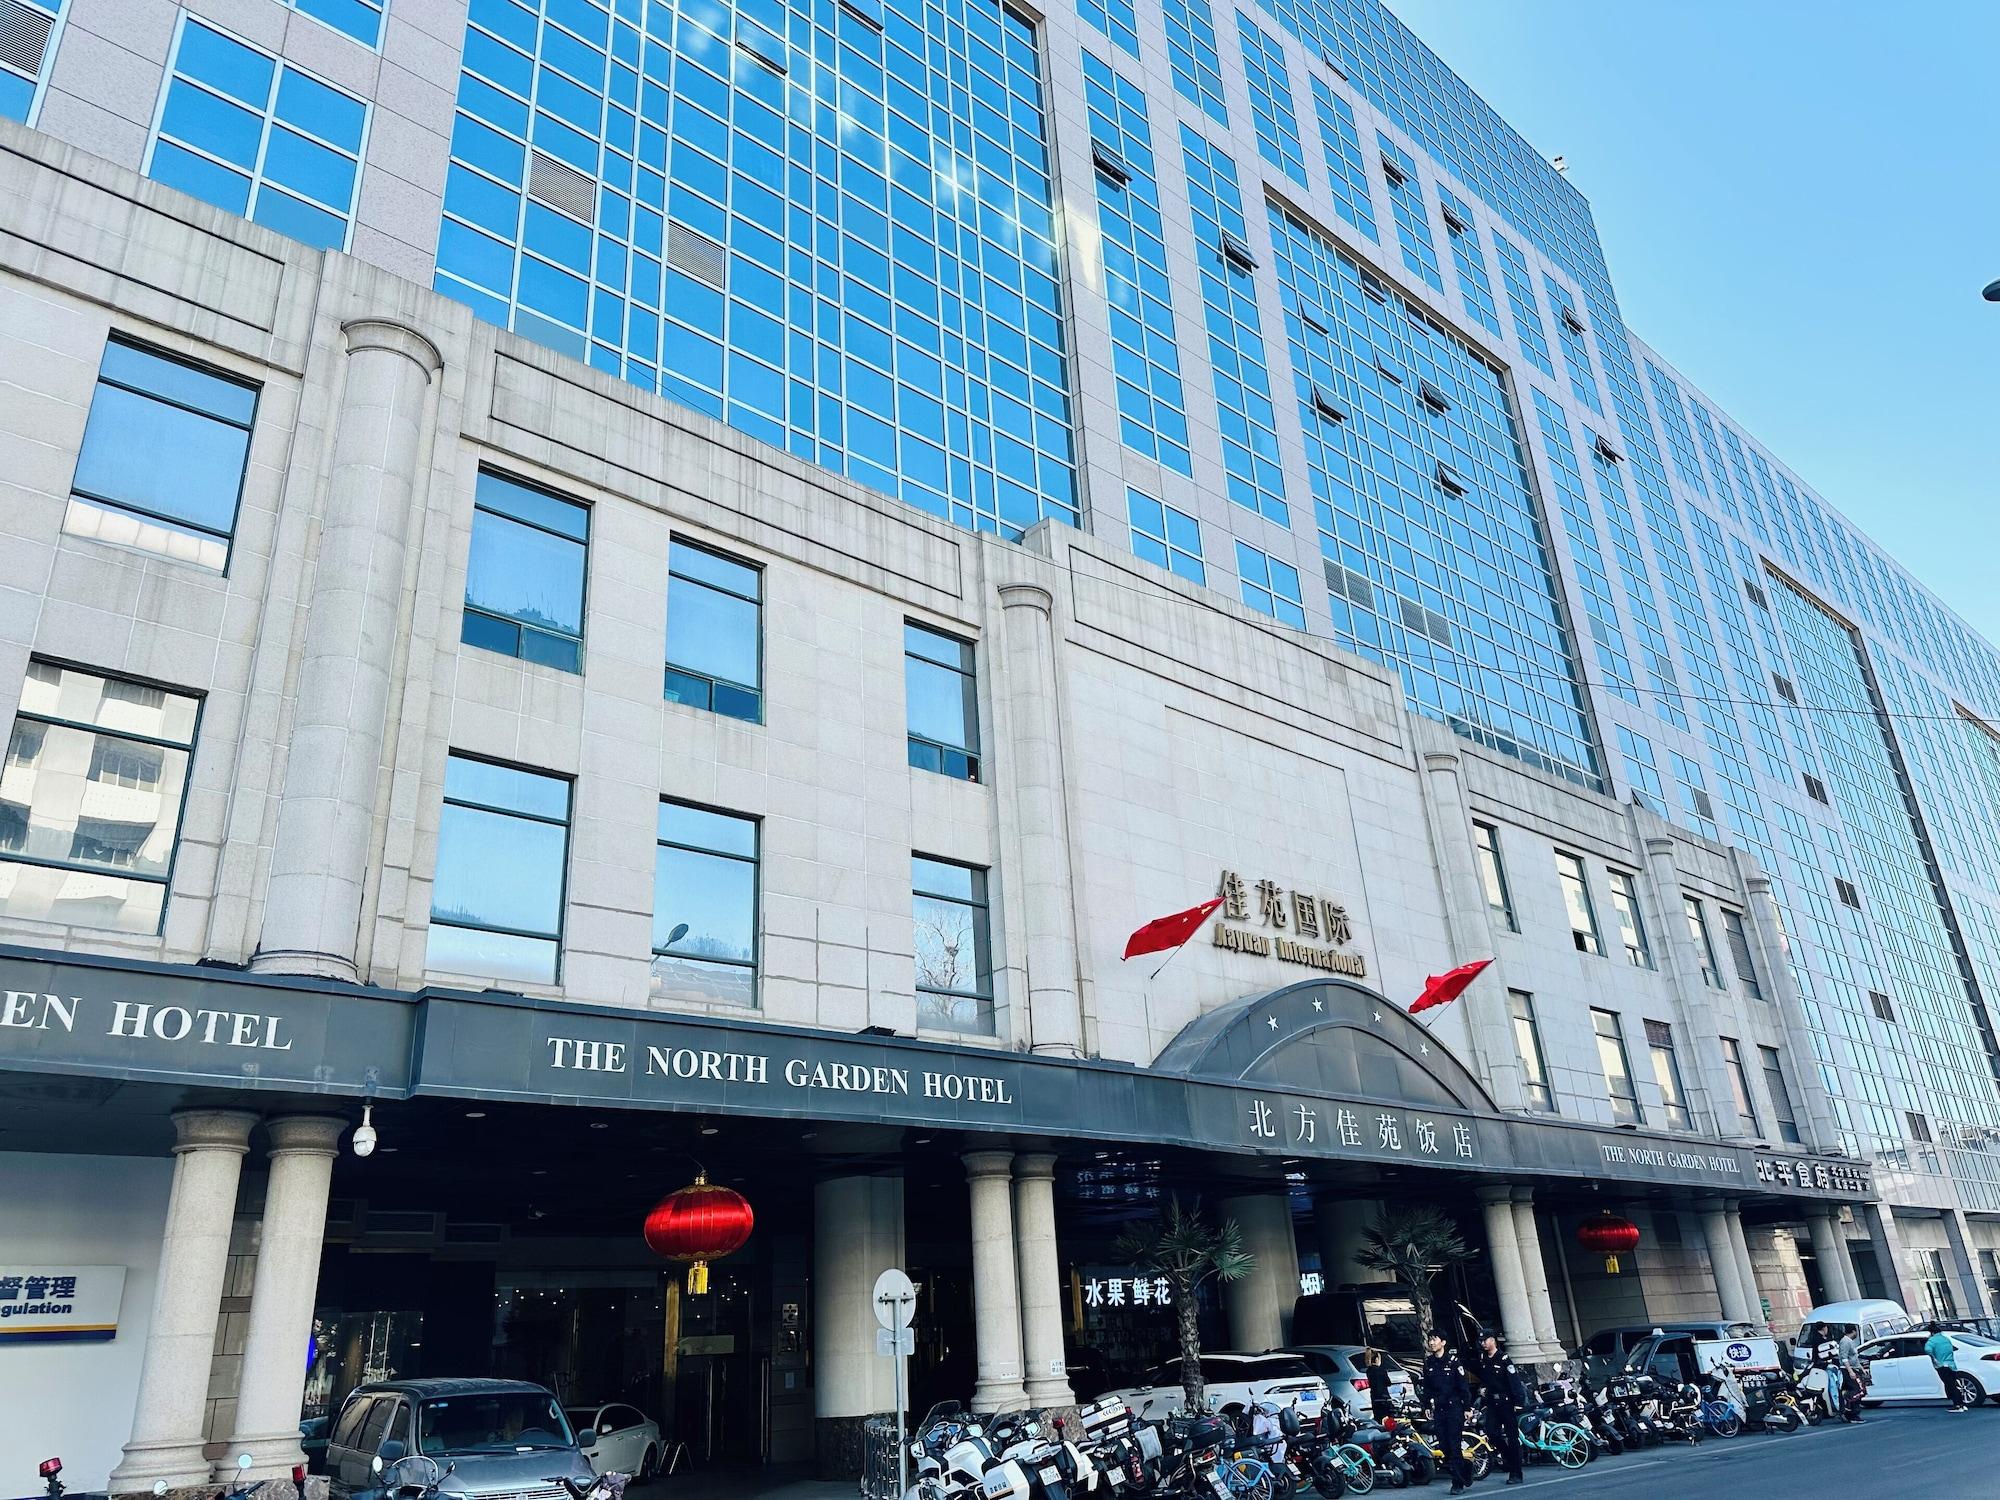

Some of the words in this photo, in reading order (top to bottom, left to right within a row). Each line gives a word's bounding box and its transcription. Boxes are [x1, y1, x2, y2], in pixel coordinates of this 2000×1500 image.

[1217, 869, 1352, 945] 佳苑国际
[1276, 936, 1367, 977] International
[0, 990, 82, 1032] EN
[106, 1000, 293, 1050] HOTEL
[547, 1037, 626, 1073] THE
[645, 1046, 769, 1084] NORTH
[784, 1059, 909, 1096] GARDEN
[922, 1071, 1013, 1104] HOTEL
[1248, 1099, 1474, 1159] 北方佳苑饭店
[1602, 1145, 1626, 1163] THE
[1627, 1148, 1665, 1166] NORTH
[1667, 1152, 1707, 1170] GARDEN
[1708, 1156, 1741, 1173] HOTEL
[1755, 1159, 1829, 1189] 北平食府
[0, 1276, 76, 1300] 督管理
[1085, 1278, 1125, 1308] 水果
[1132, 1277, 1171, 1306] 鲜花
[0, 1302, 72, 1317] gulation
[1728, 1347, 1750, 1359] 快递
